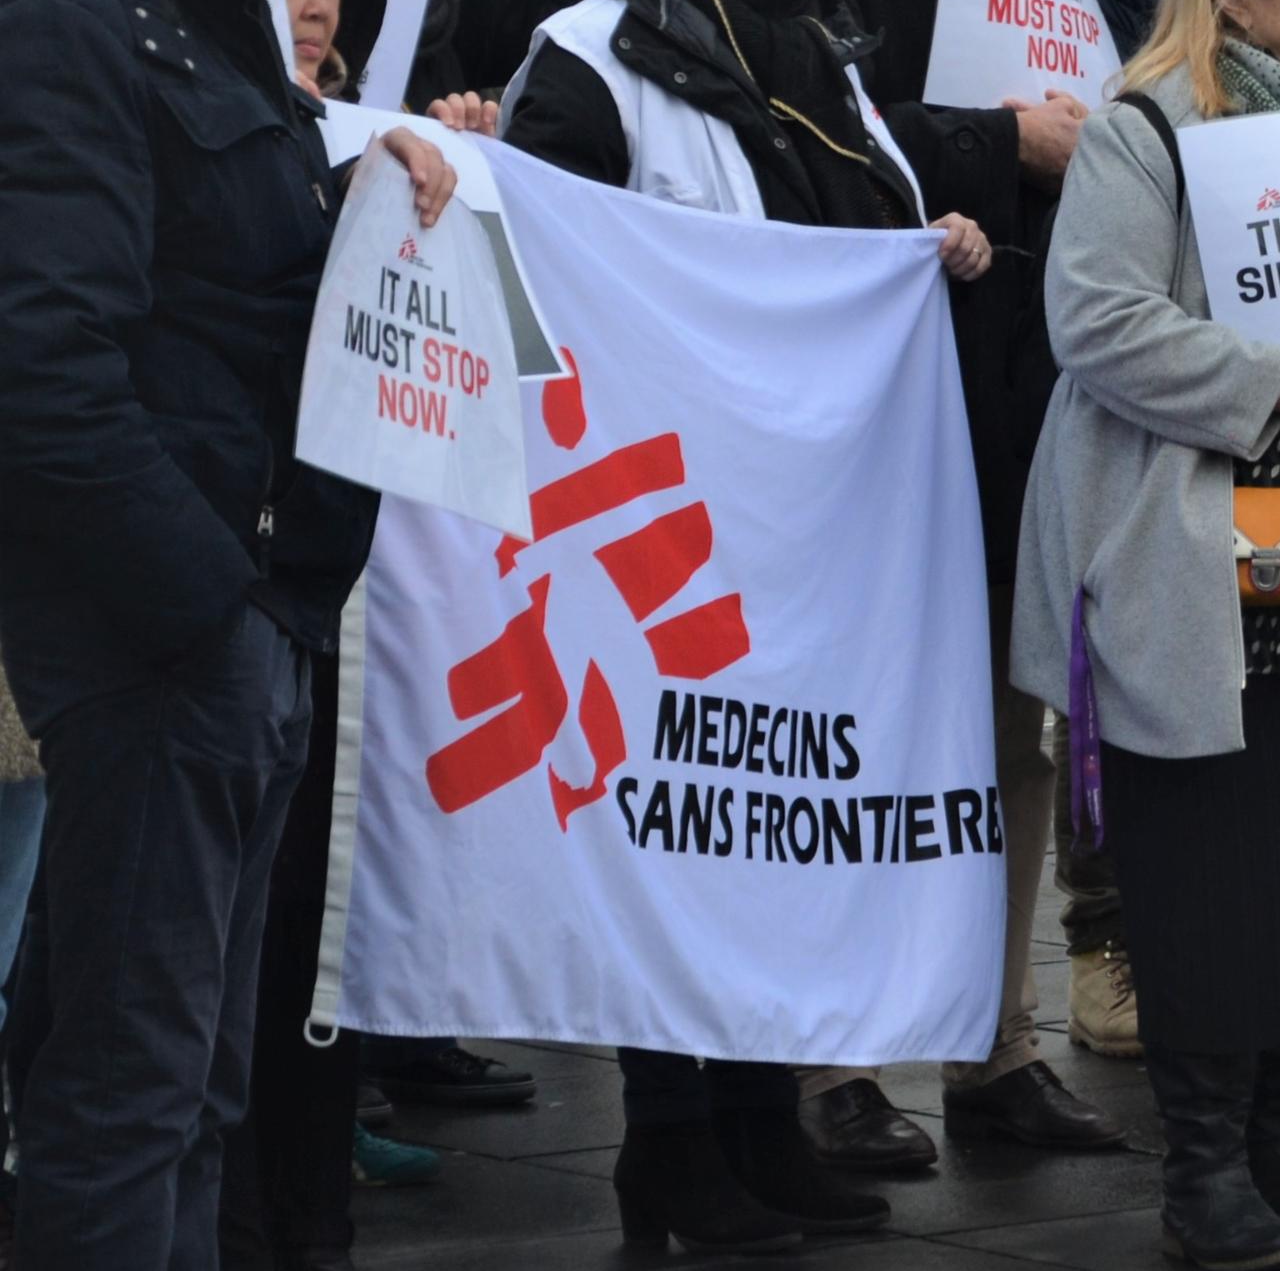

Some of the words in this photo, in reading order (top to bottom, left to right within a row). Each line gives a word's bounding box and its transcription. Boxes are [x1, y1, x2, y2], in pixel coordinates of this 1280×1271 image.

[1027, 35, 1085, 79] NOW.
[1060, 4, 1100, 46] STOP
[379, 265, 401, 315] IT
[405, 279, 456, 335] ALL
[344, 304, 416, 374] MUST
[422, 337, 490, 399] STOP
[378, 374, 455, 440] NOW.
[653, 689, 861, 780] MEDECINS
[616, 777, 734, 857] SANS
